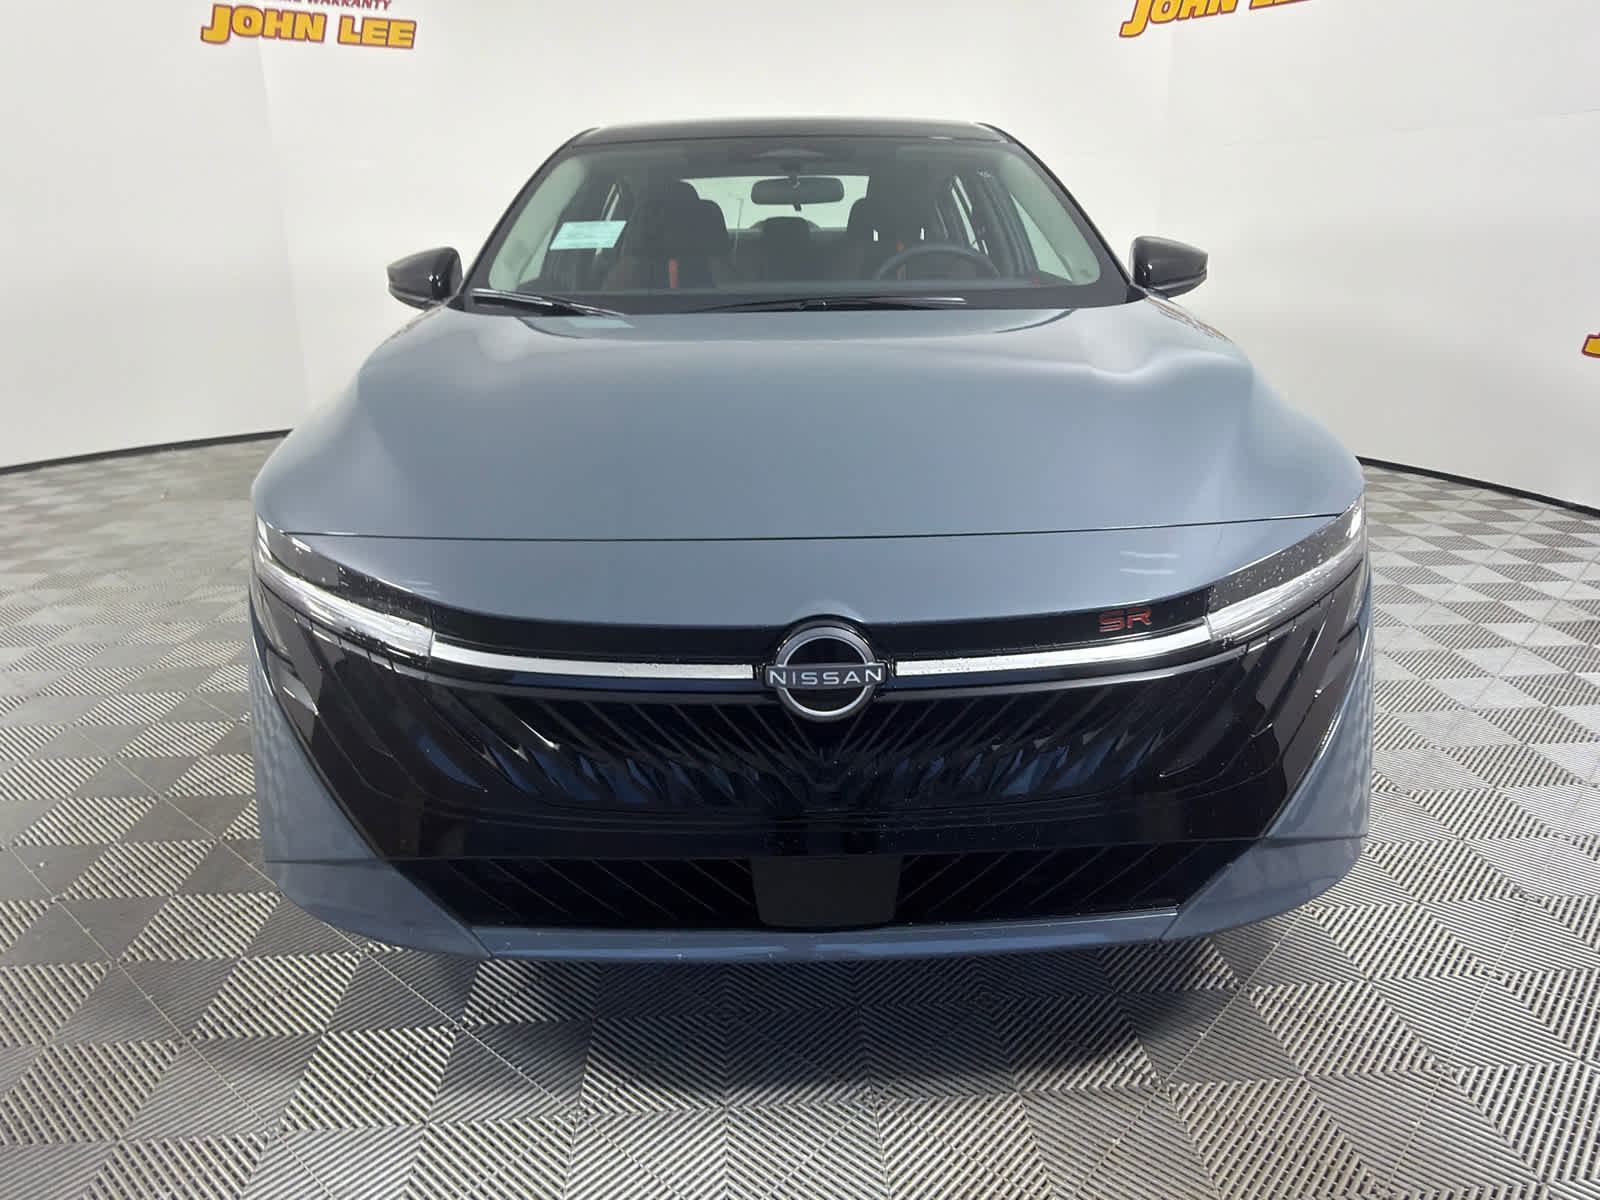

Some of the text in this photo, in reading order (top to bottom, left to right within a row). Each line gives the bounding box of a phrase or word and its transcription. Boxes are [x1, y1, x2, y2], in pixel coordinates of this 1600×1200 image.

[201, 4, 417, 49] JOHN LEE
[1098, 607, 1153, 632] SR
[768, 667, 882, 685] NISSAN
